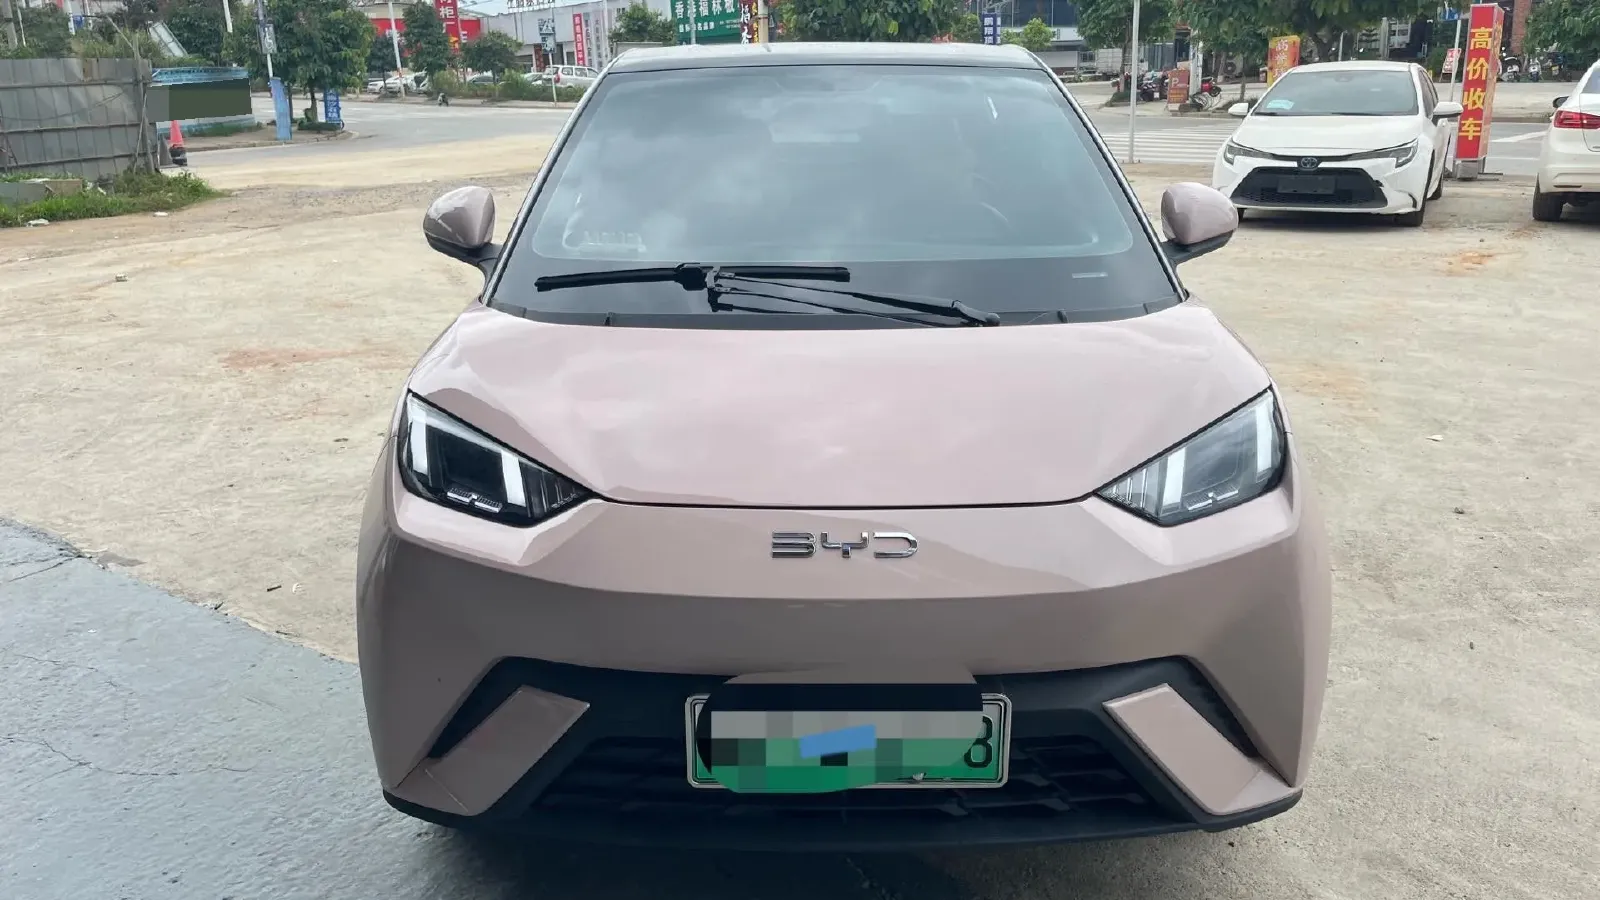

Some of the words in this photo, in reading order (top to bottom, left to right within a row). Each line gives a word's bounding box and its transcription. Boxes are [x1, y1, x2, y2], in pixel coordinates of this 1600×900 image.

[1458, 26, 1493, 141] 高价收车
[771, 531, 918, 559] BYD
